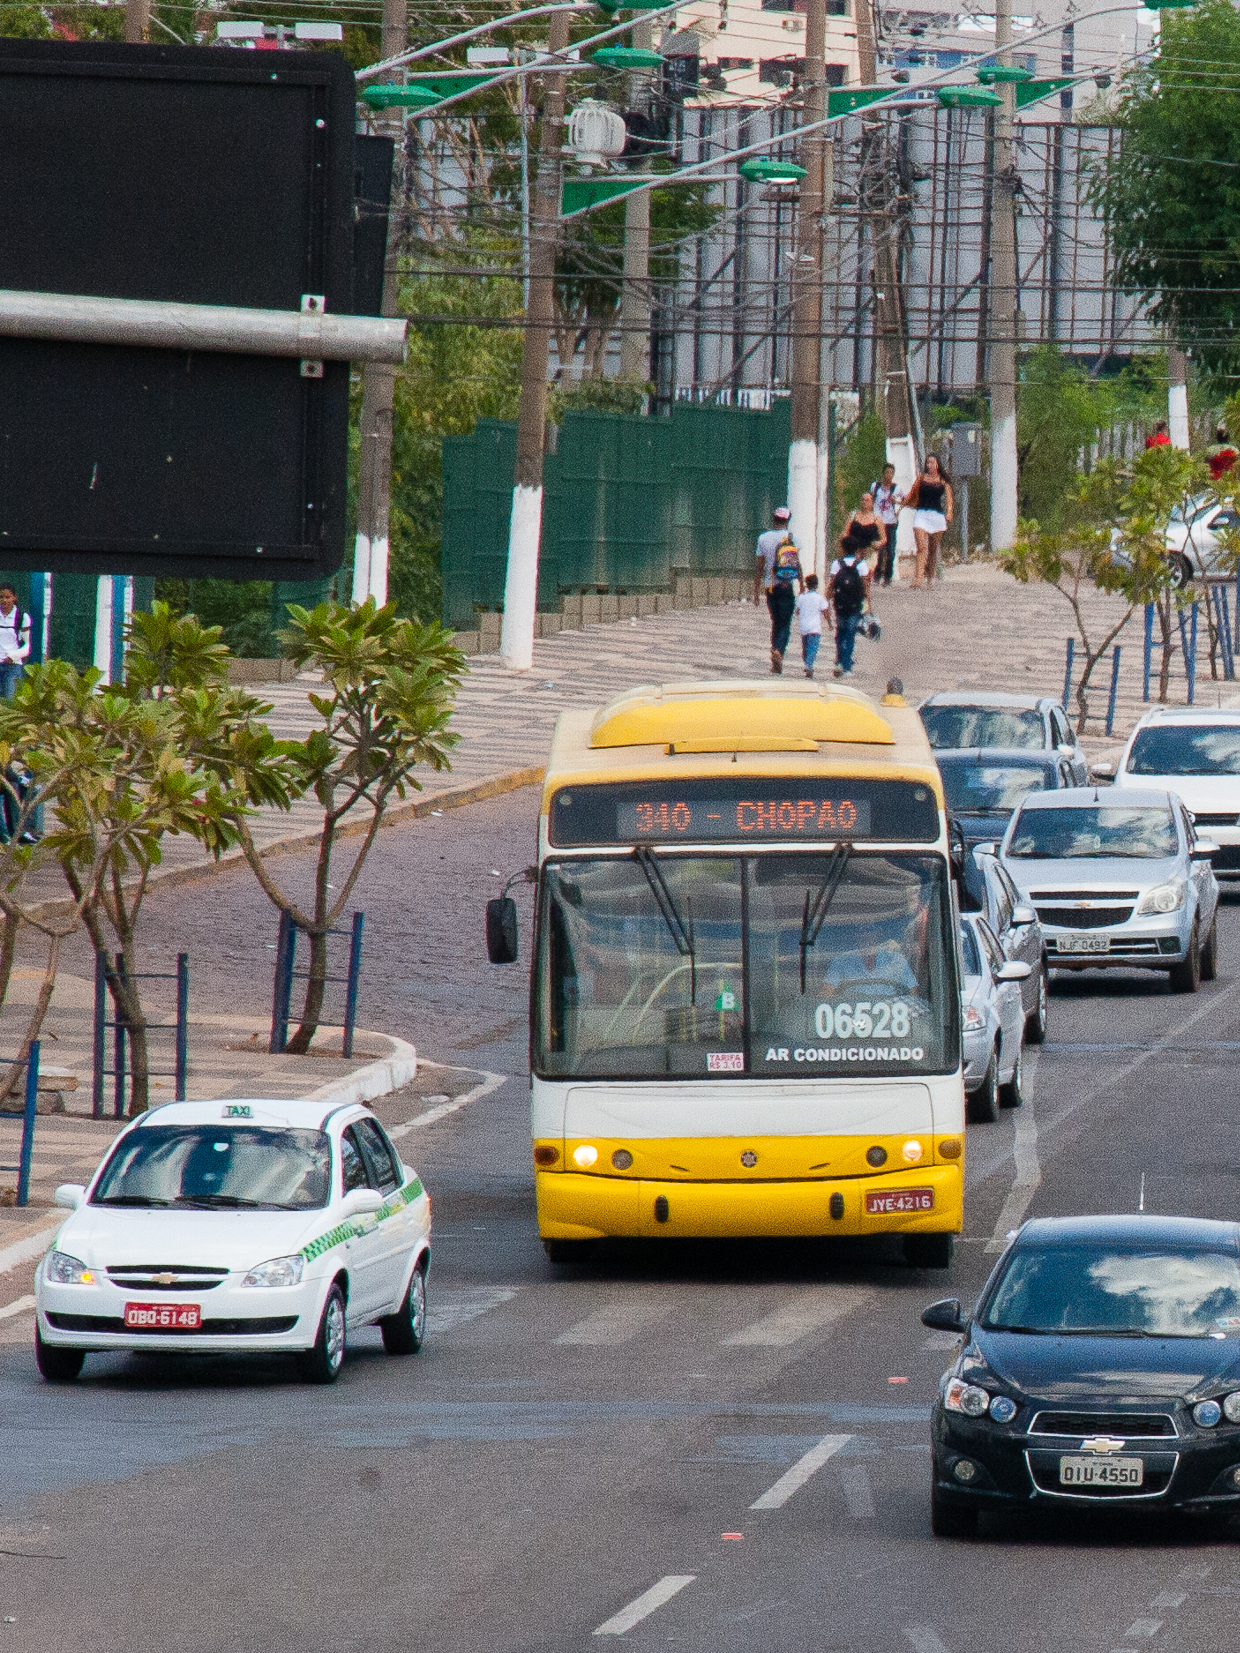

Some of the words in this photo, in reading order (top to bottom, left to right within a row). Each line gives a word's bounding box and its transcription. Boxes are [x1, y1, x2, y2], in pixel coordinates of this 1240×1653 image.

[635, 802, 691, 831] 340
[736, 800, 857, 830] CHOPAO
[814, 1001, 911, 1039] 06528
[765, 1047, 790, 1062] AR
[794, 1047, 925, 1062] CONDICIONADO
[226, 1105, 251, 1116] TAXI
